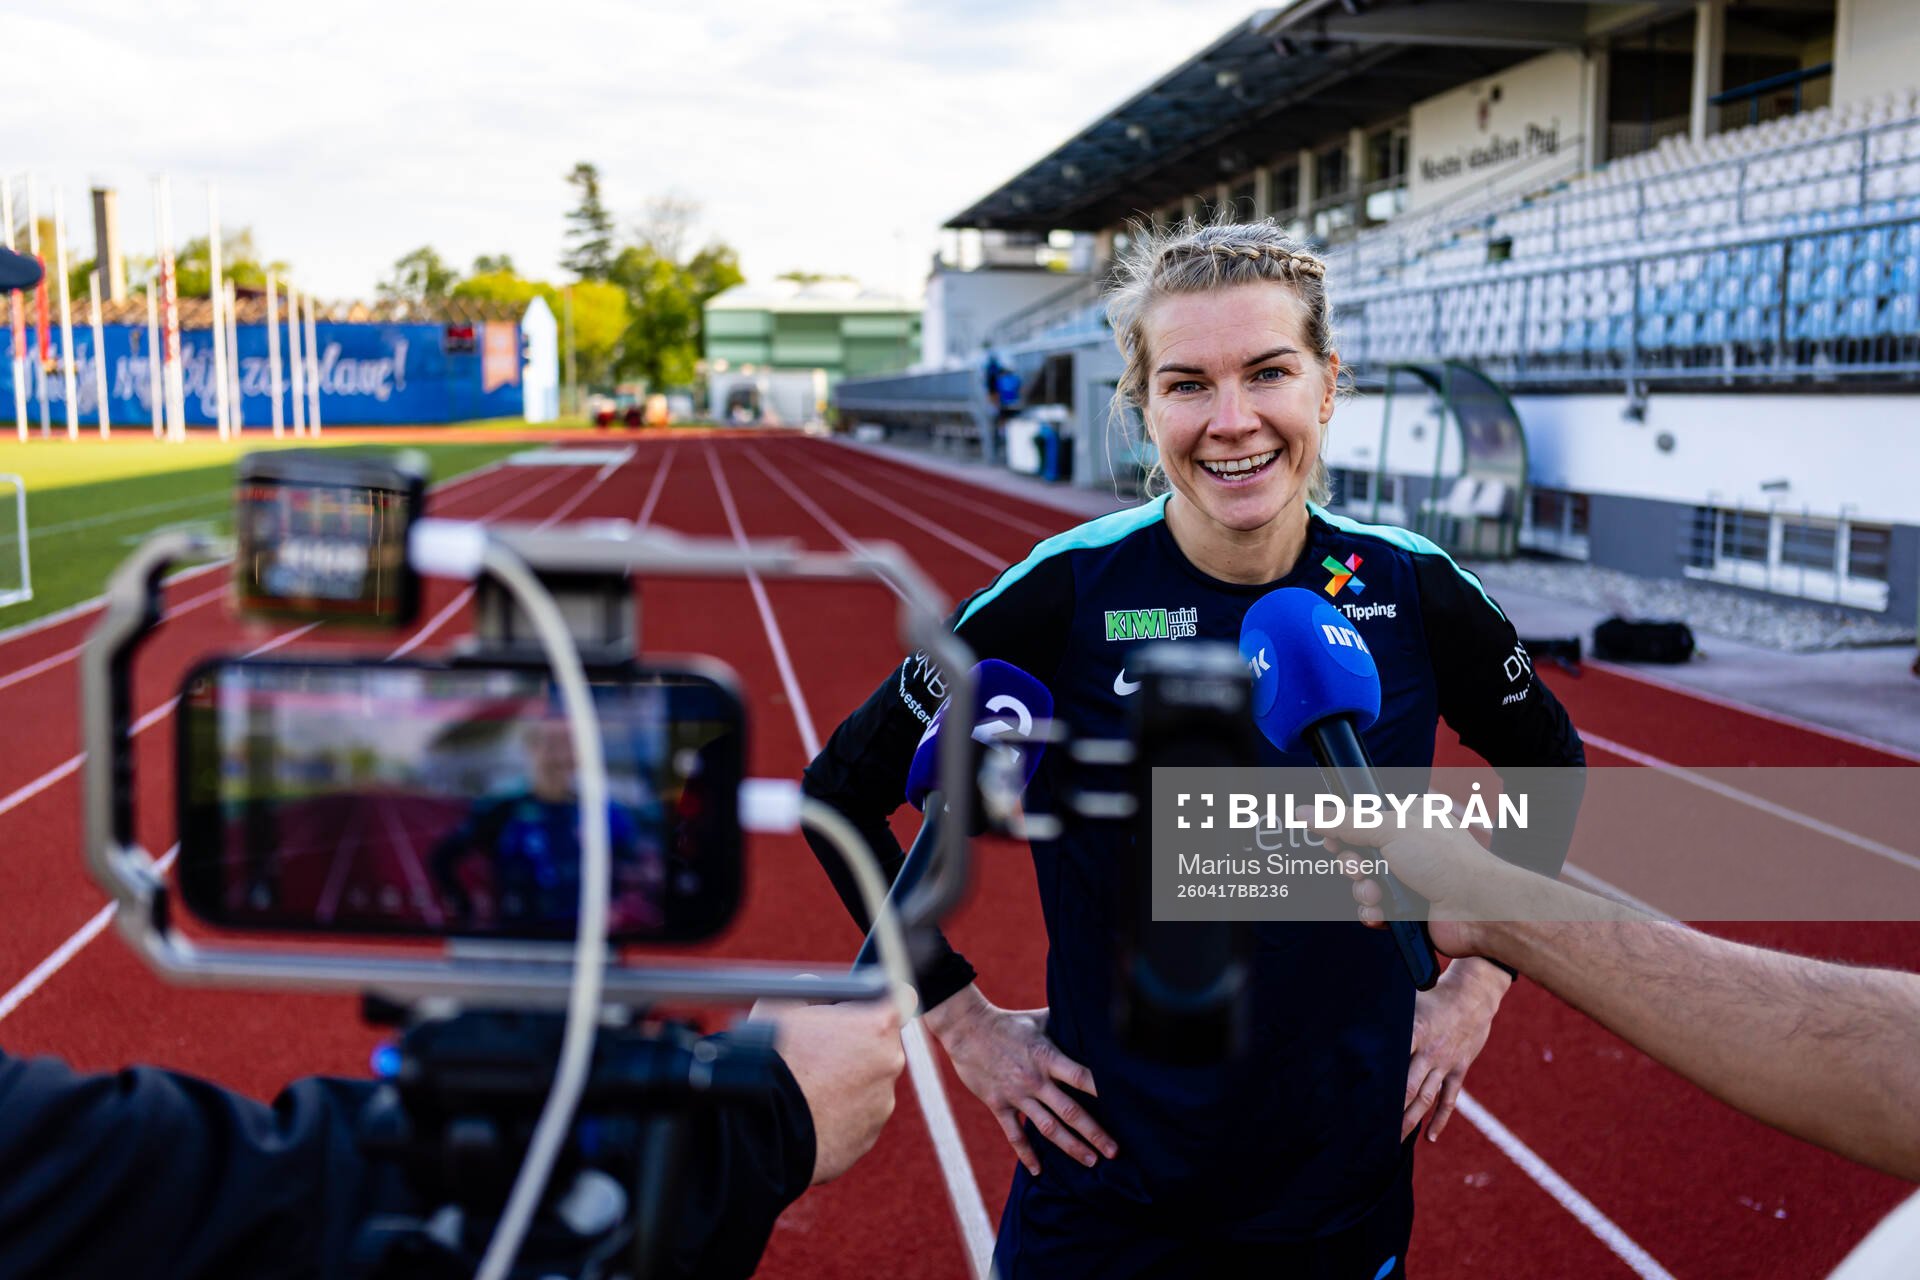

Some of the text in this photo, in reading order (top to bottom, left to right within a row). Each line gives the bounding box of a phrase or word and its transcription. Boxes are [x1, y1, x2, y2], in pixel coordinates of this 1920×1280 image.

[1168, 607, 1198, 624] mini
[1342, 602, 1397, 621] Tipping
[1105, 608, 1169, 641] KIWI
[1169, 622, 1197, 640] pris
